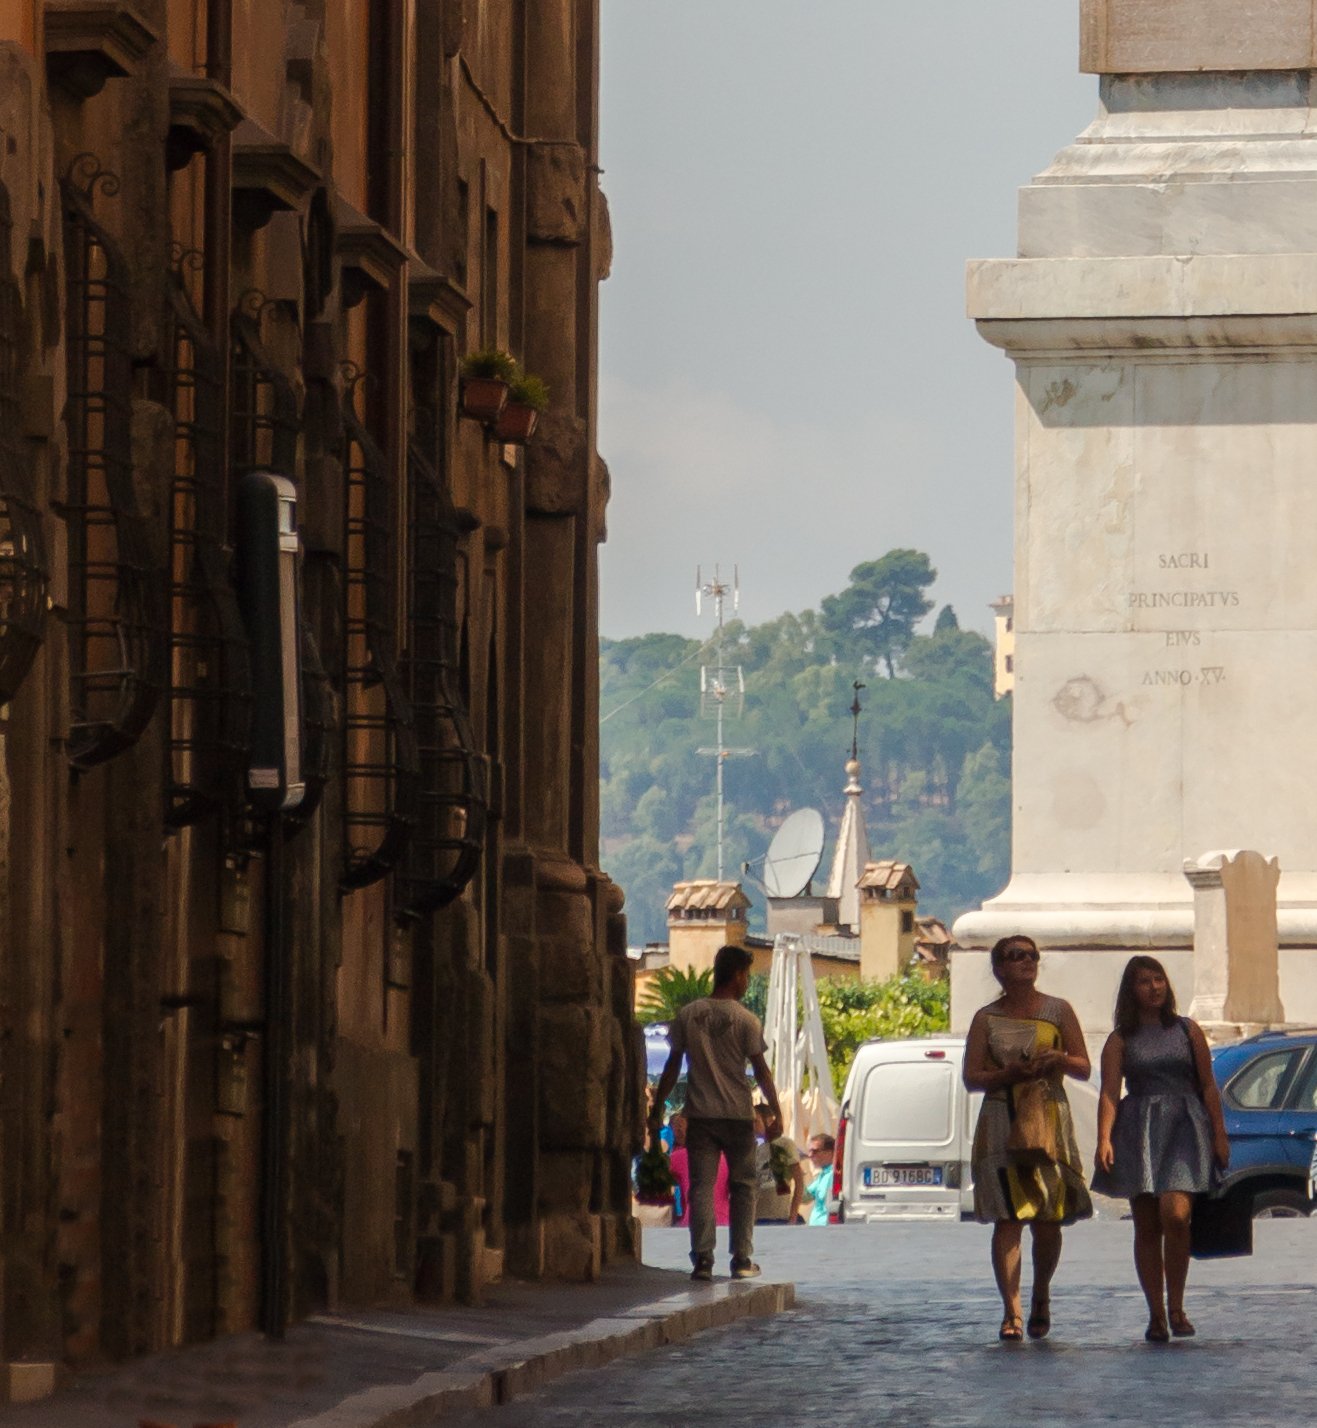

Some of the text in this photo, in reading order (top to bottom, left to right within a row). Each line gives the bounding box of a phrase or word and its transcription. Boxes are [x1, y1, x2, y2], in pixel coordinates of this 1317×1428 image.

[1158, 553, 1208, 568] SACRI
[1127, 591, 1240, 608] PRINCIPATVS
[1165, 630, 1201, 646] EIVS
[1141, 669, 1192, 685] ANNO
